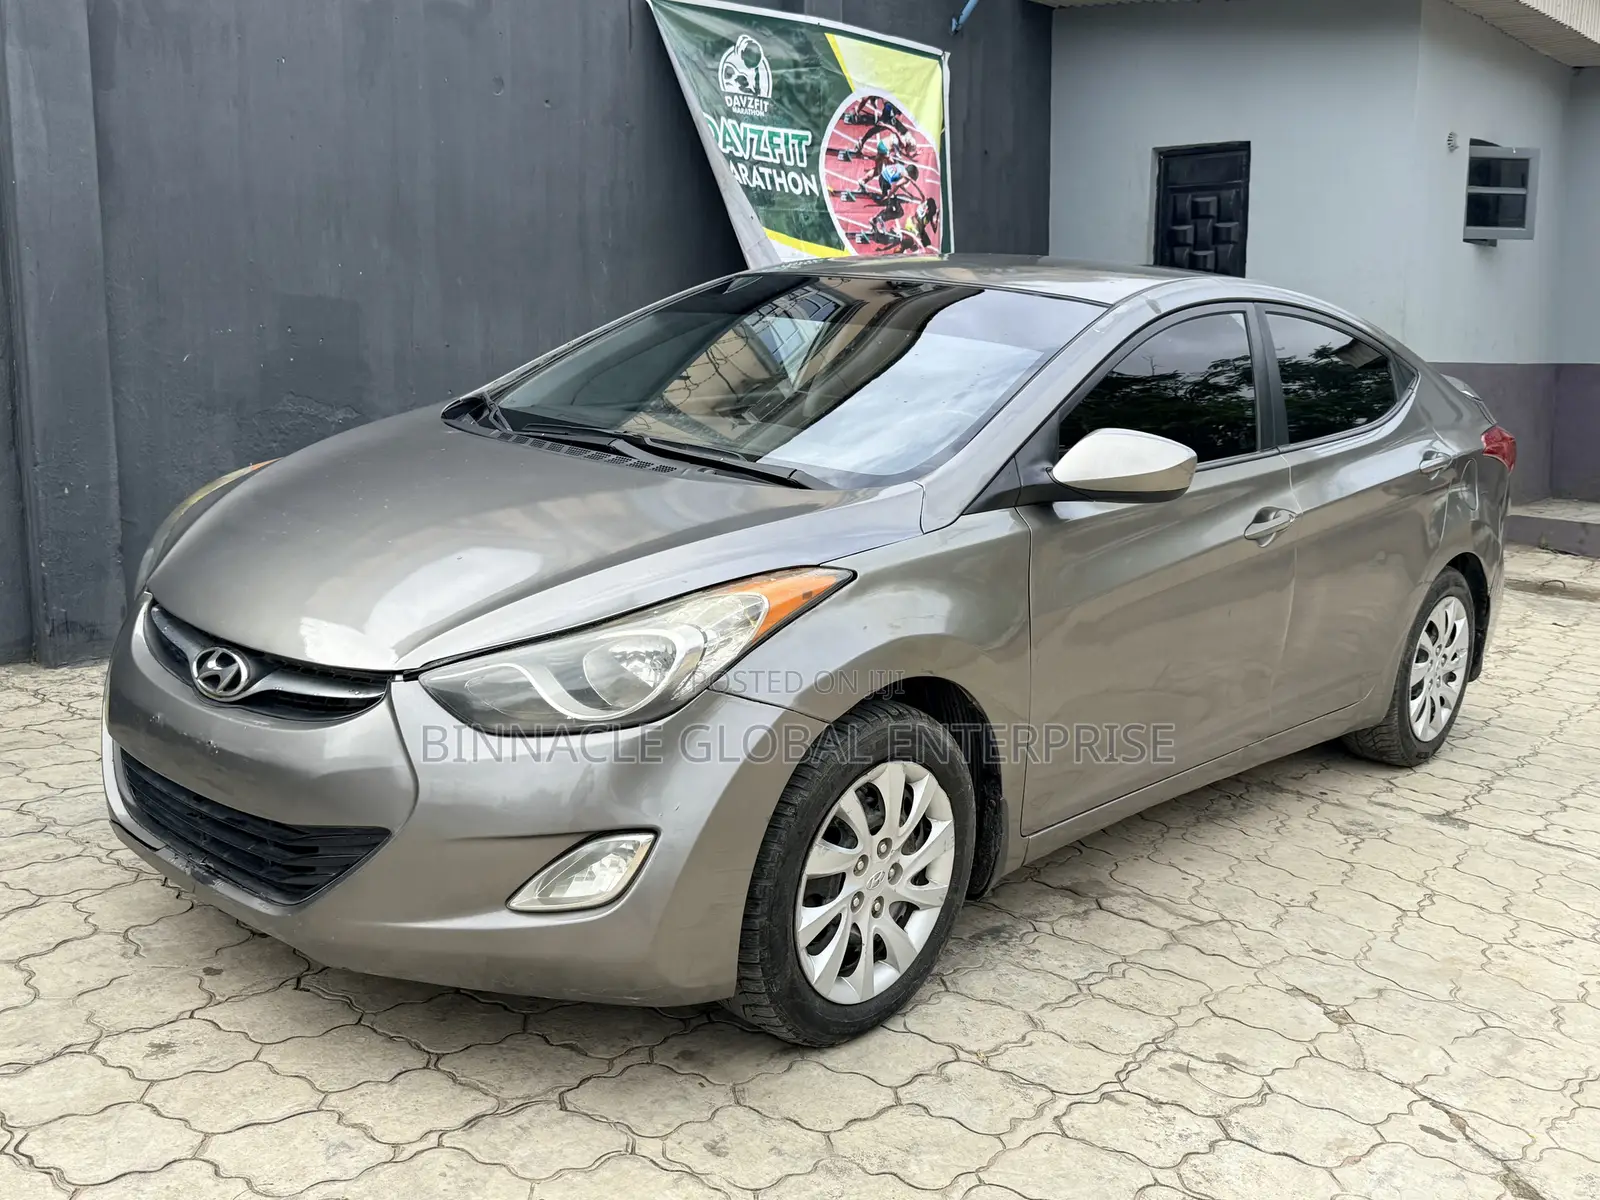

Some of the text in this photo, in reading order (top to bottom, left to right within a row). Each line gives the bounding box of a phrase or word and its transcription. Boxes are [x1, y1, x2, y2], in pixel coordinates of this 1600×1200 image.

[725, 95, 770, 113] DAVZFIT
[731, 106, 765, 117] MARATHON
[729, 160, 820, 197] ARATHON
